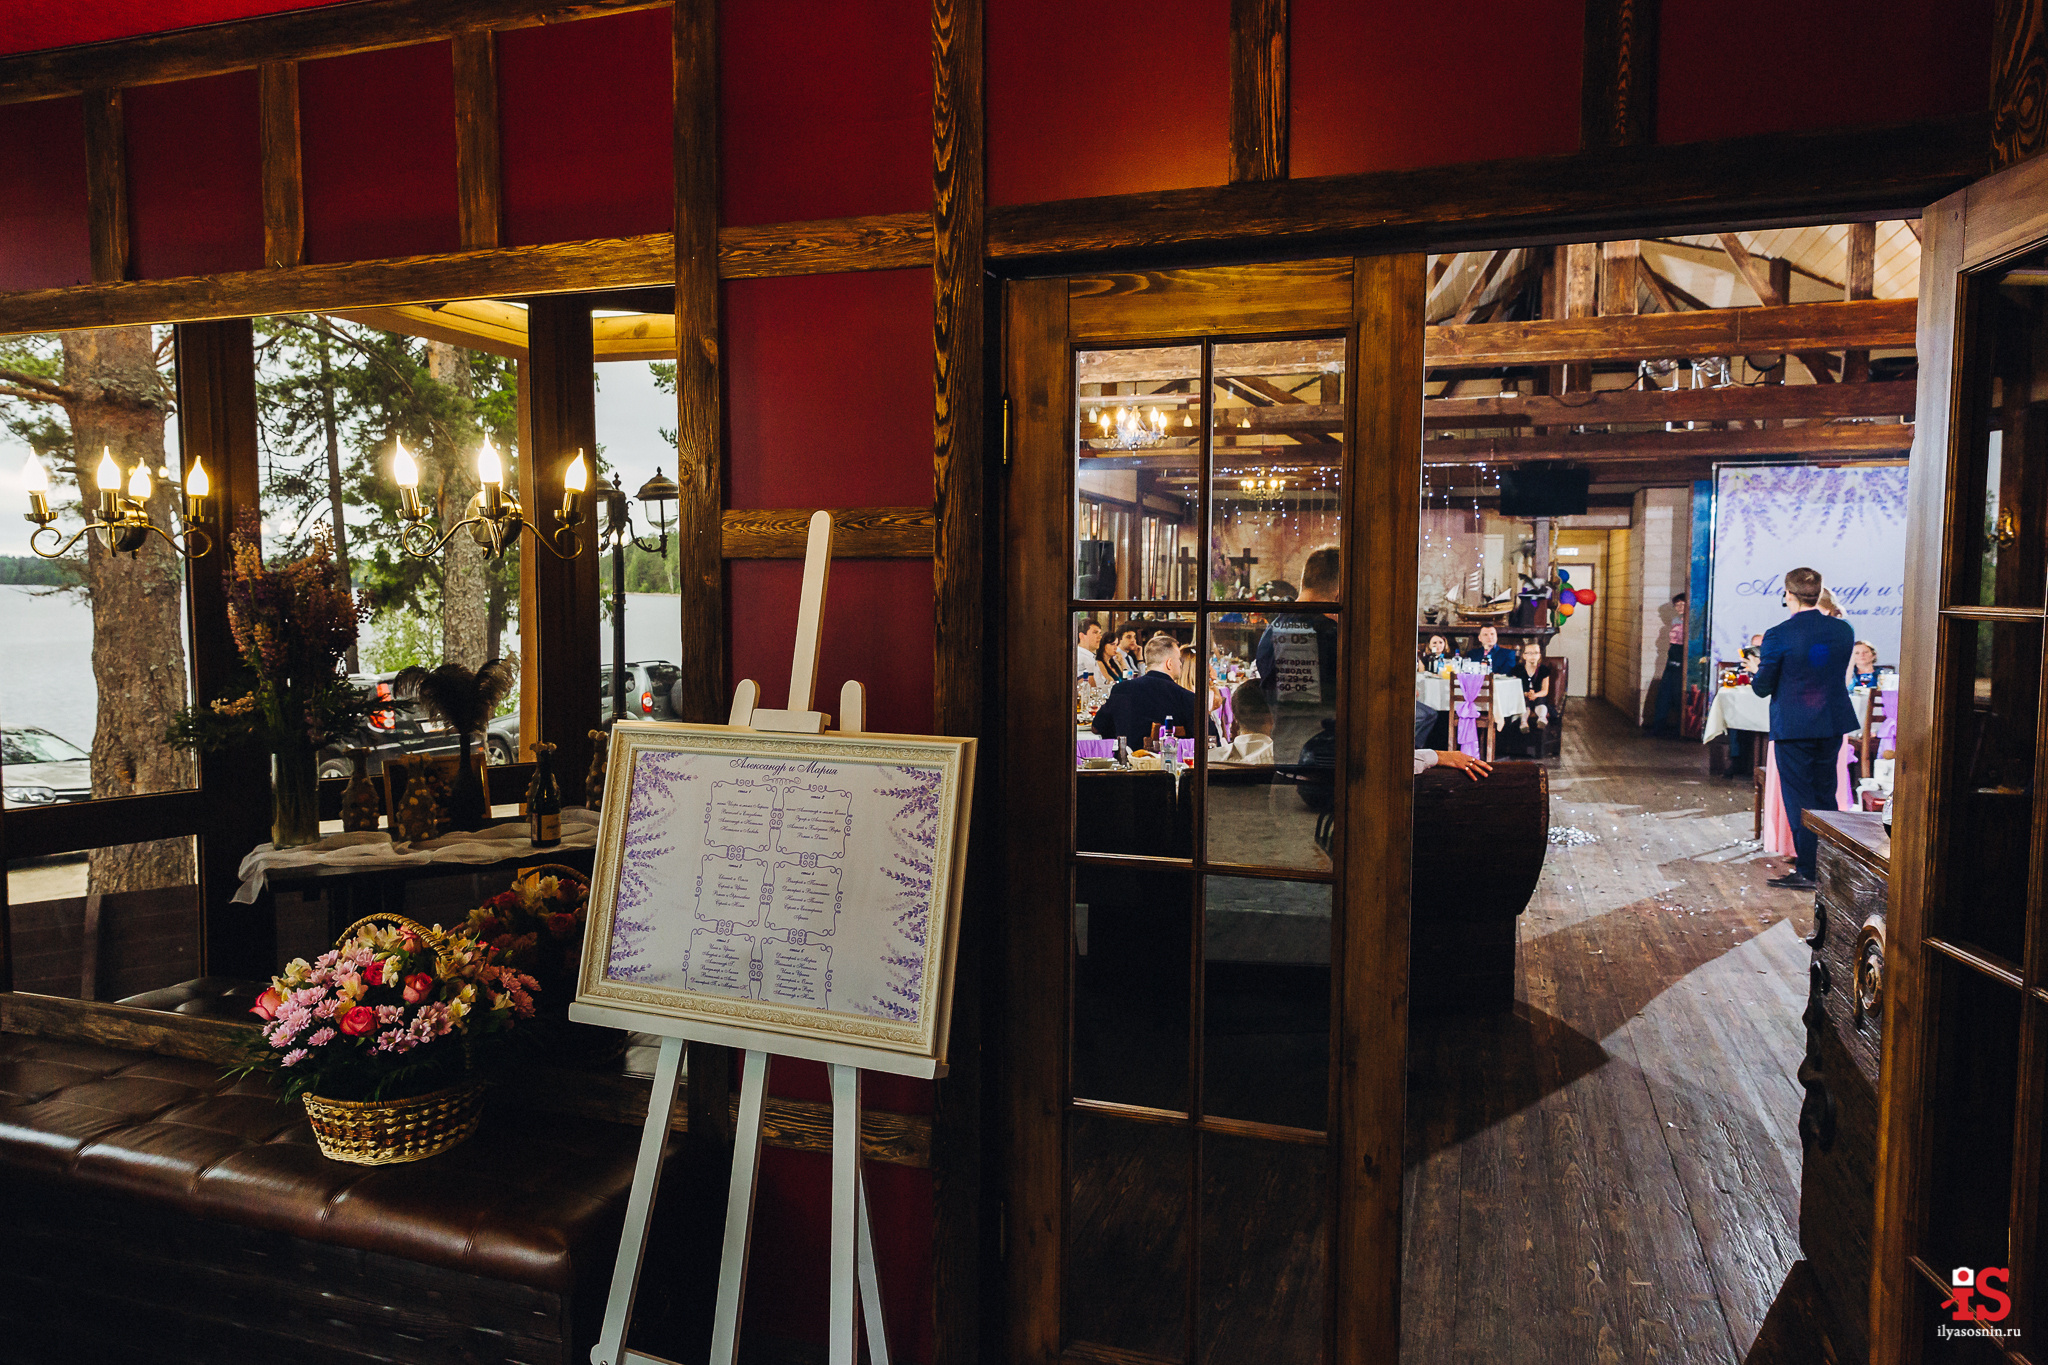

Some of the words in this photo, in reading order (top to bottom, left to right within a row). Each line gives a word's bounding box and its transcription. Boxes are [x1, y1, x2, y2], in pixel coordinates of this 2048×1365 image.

[1736, 574, 1870, 605] Алндр
[1878, 586, 1893, 596] и
[1273, 620, 1308, 629] одные
[1275, 658, 1316, 666] ойгарант
[730, 757, 786, 776] Александр
[797, 760, 838, 778] Мария
